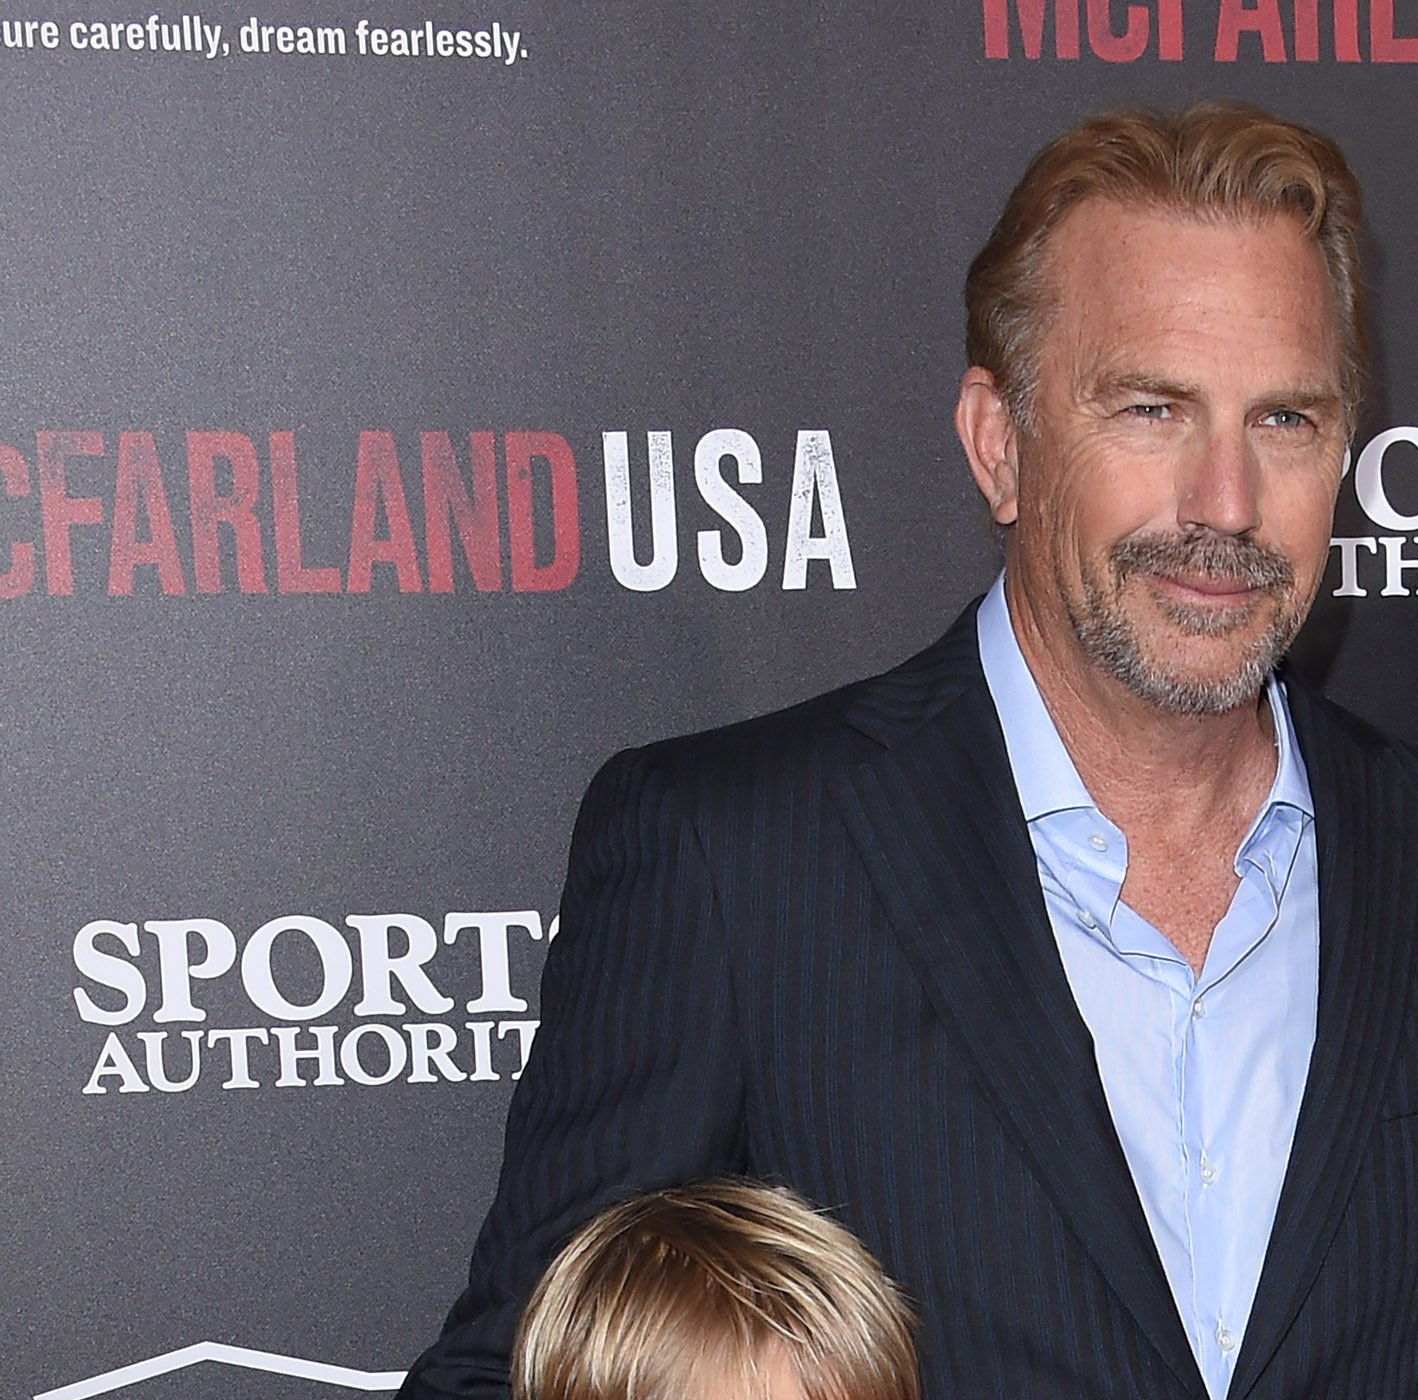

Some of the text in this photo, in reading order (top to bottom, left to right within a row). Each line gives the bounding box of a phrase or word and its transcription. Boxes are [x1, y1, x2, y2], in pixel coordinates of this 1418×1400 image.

[0, 15, 528, 65] ure carefully, dream fearlessly.
[602, 429, 857, 591] USA
